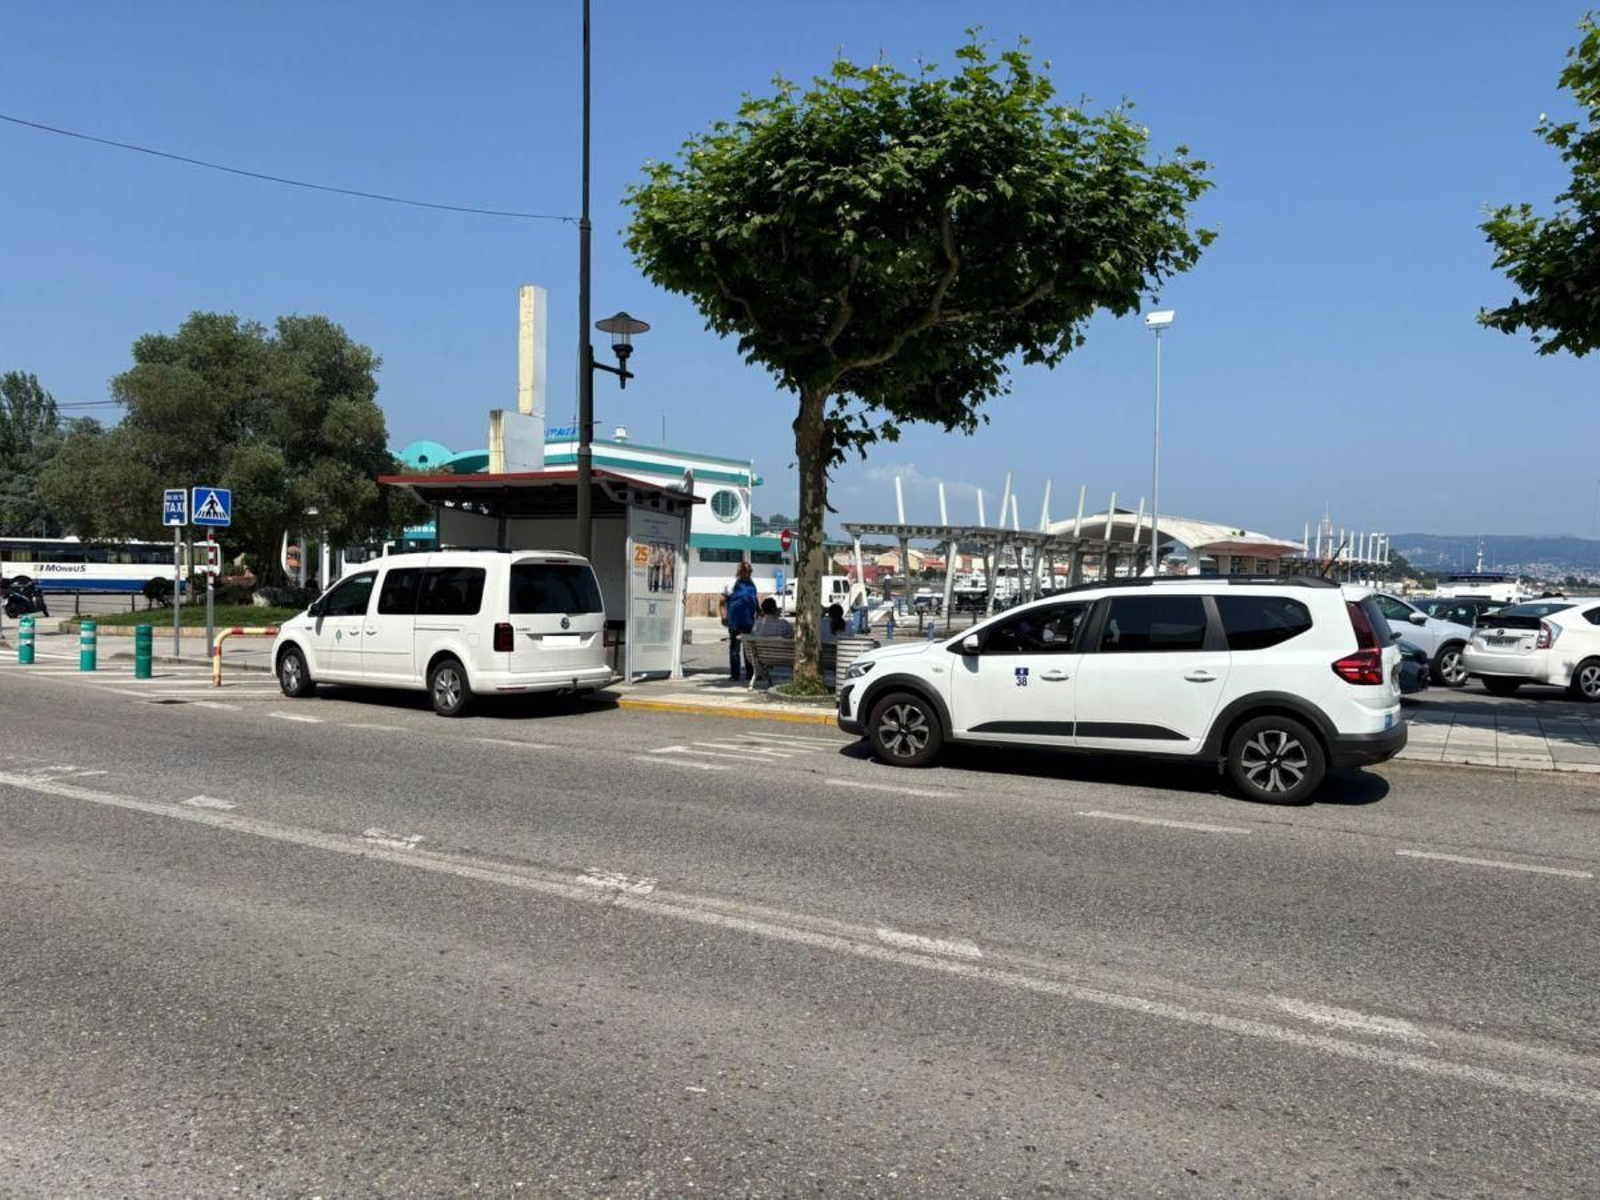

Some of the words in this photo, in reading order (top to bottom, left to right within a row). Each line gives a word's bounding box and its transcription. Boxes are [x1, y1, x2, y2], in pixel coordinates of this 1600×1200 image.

[164, 502, 186, 513] TAXI
[634, 545, 647, 562] 25
[1016, 676, 1027, 687] 38
